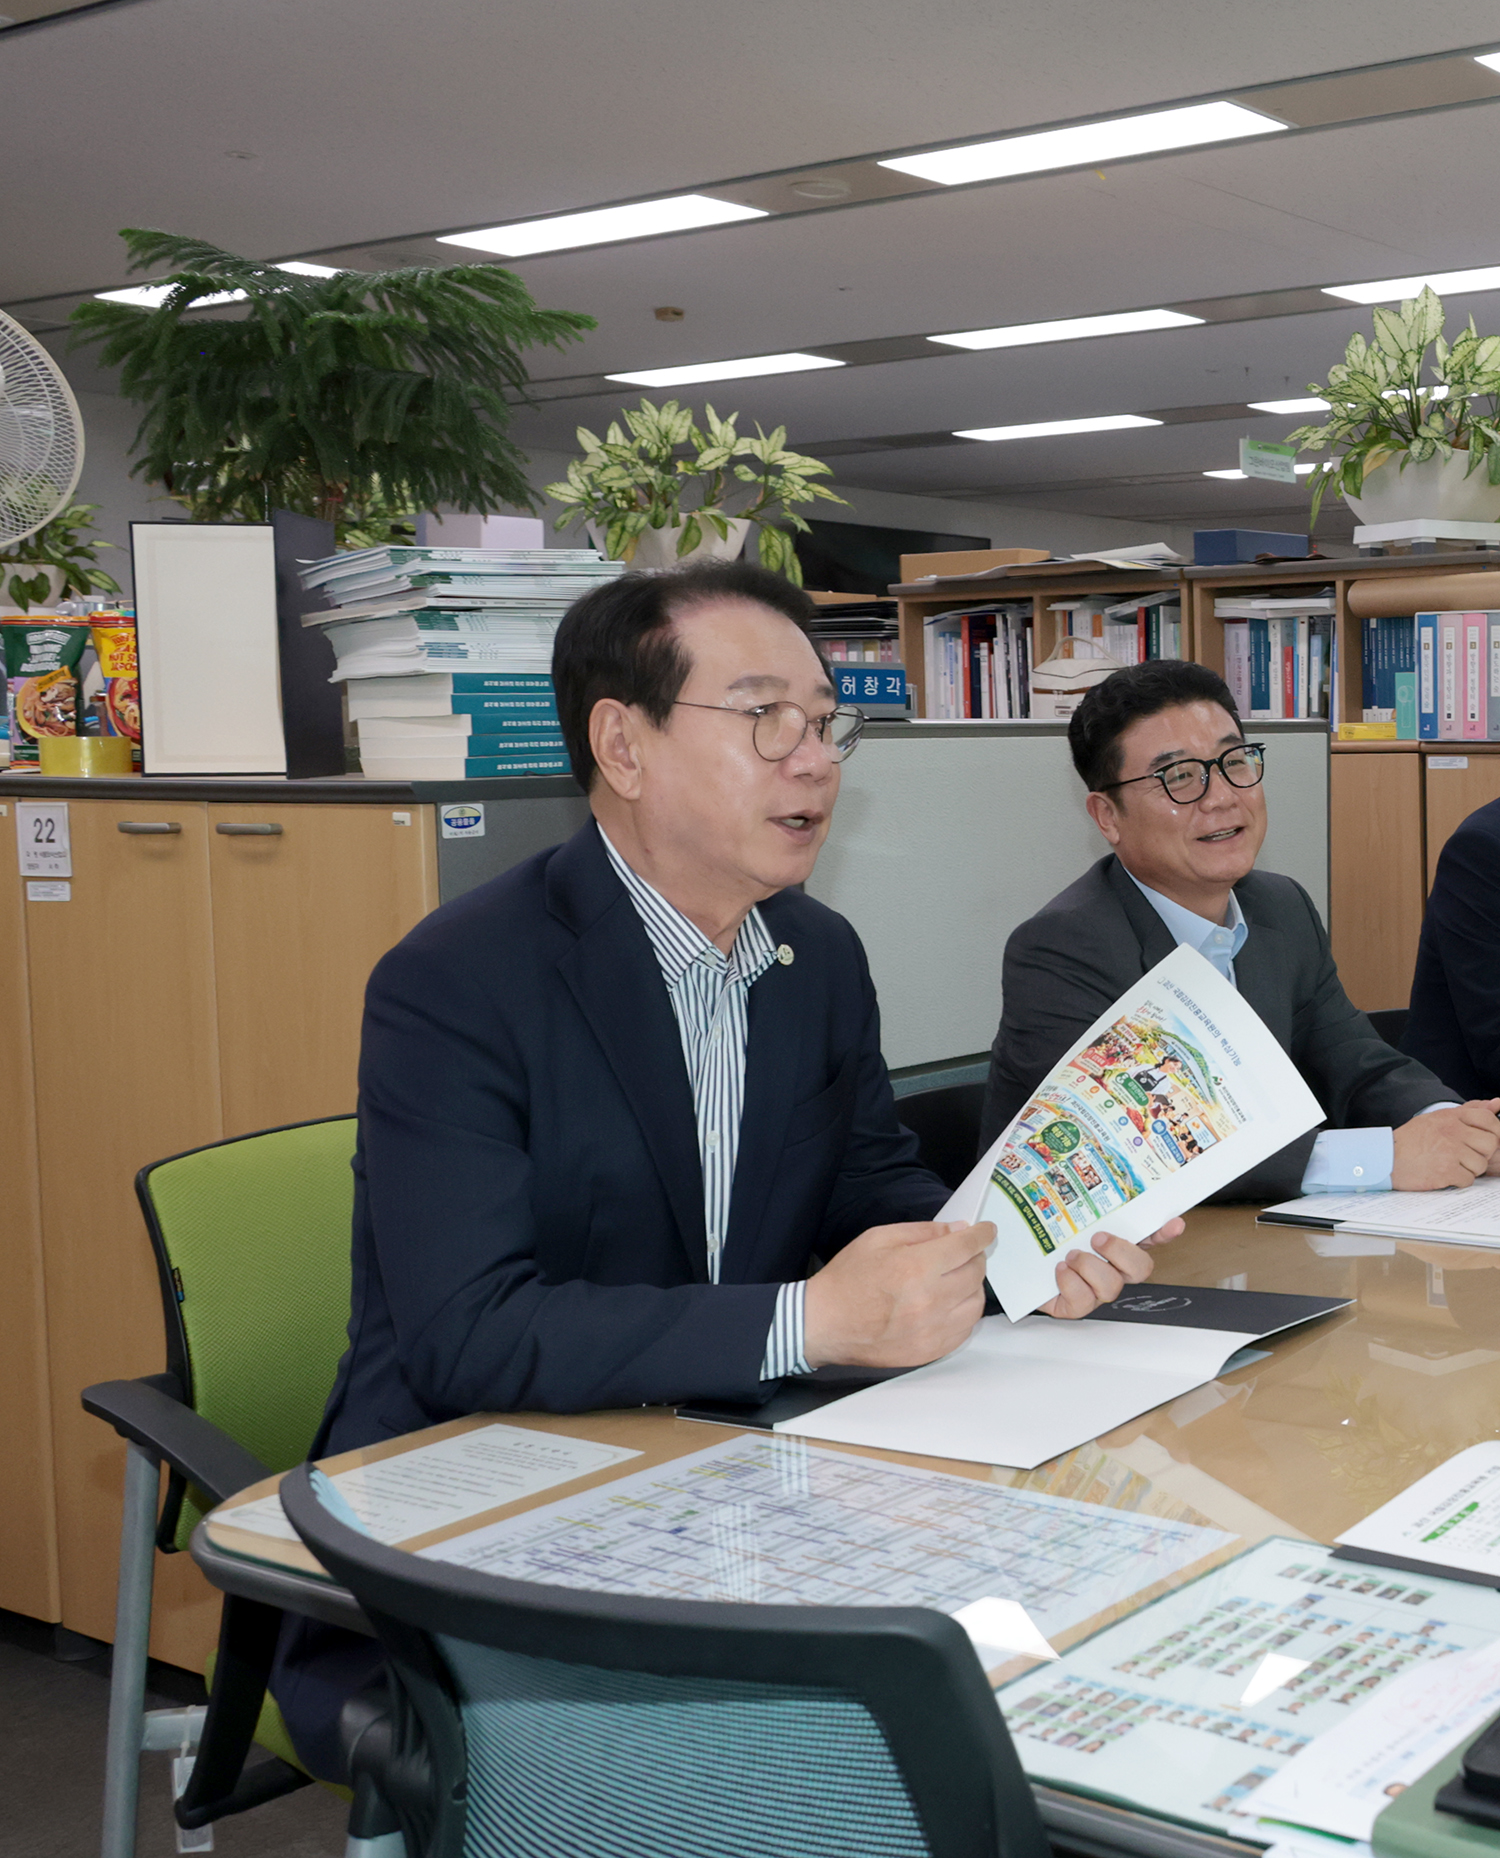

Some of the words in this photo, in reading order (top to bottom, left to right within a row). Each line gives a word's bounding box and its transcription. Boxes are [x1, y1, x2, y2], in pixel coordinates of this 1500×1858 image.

[33, 817, 56, 843] 22
[1173, 986, 1222, 1039] 국립김장진흥교육원의
[1217, 1037, 1242, 1067] 핵심기능
